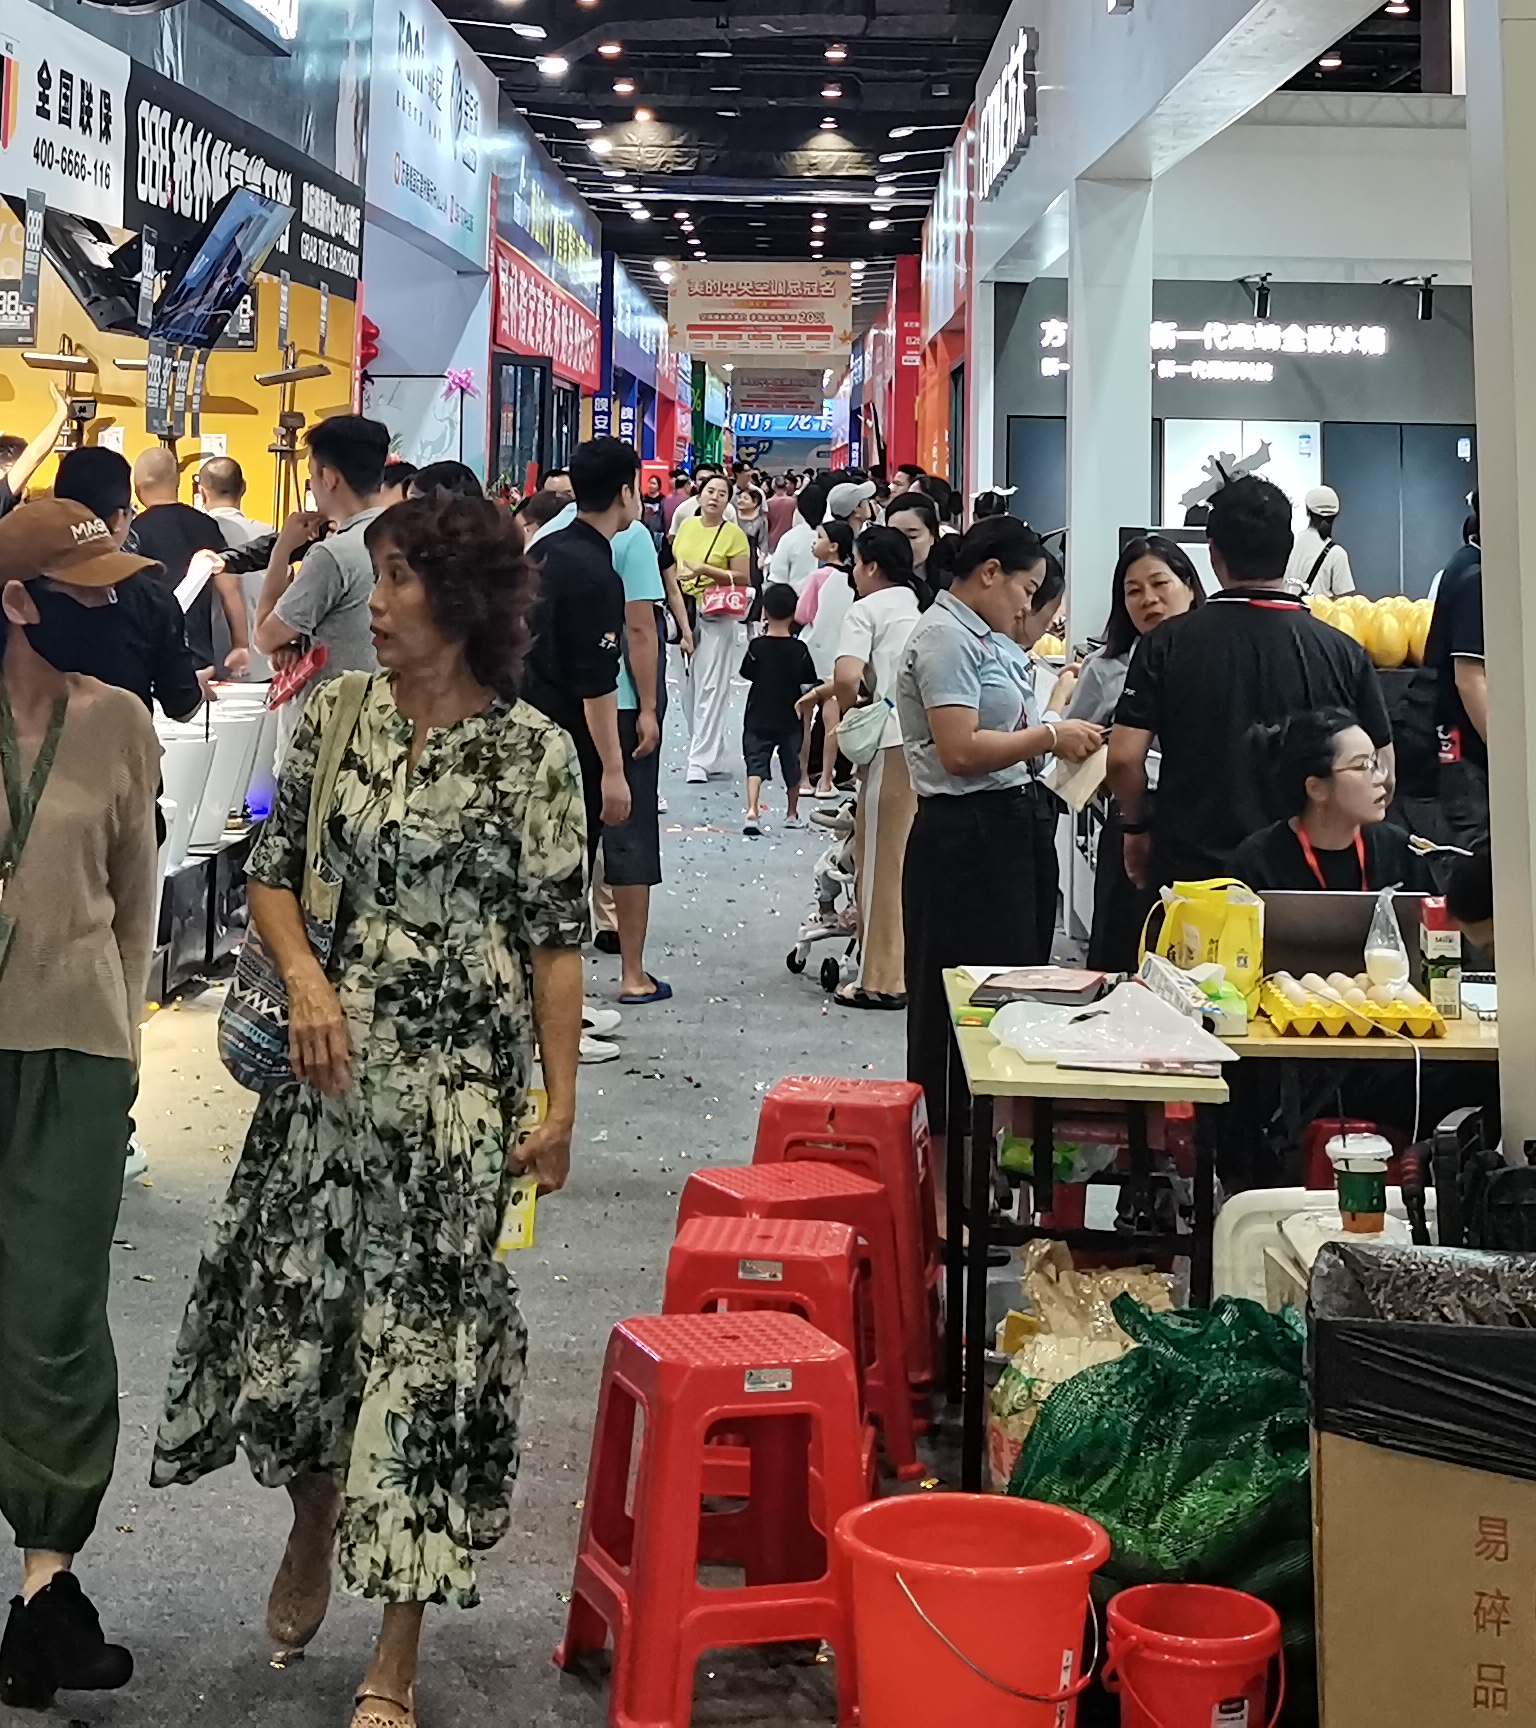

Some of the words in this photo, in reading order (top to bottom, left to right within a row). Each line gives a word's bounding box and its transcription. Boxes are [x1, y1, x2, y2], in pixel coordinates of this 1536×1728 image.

[35, 58, 113, 145] 全国联保
[33, 136, 111, 190] 400-6666-116
[1472, 1514, 1511, 1712] 易碎品
